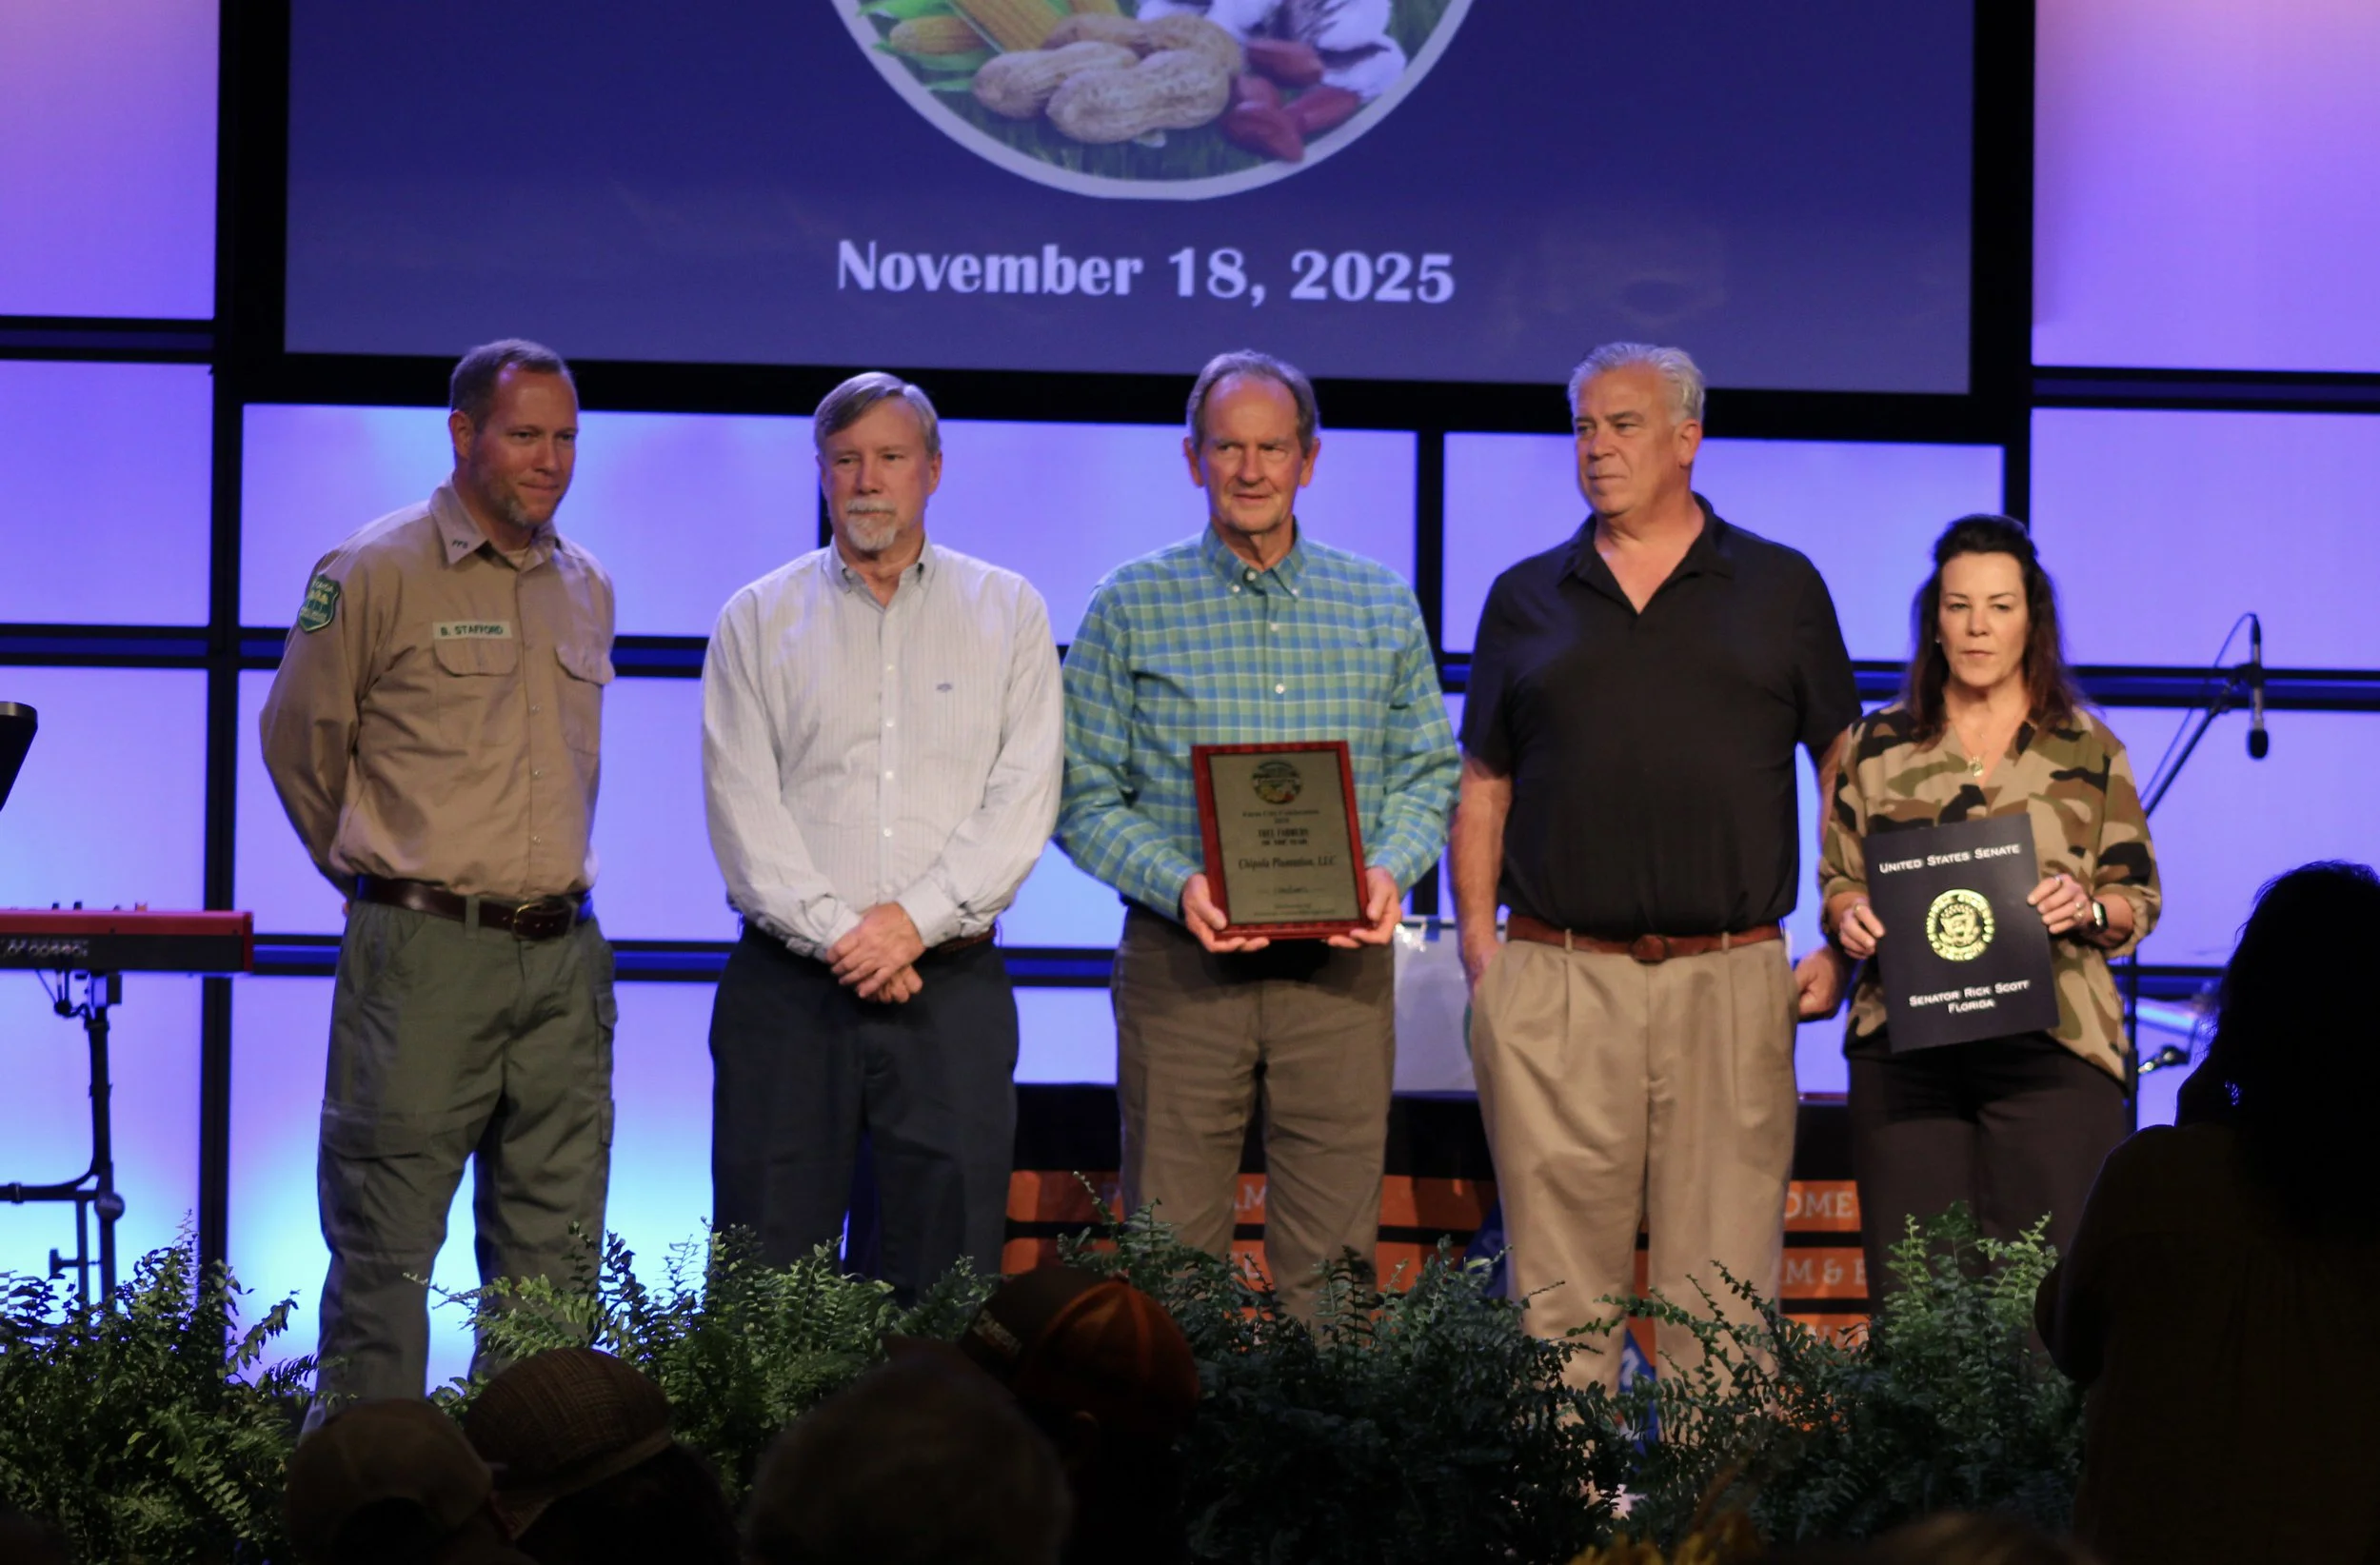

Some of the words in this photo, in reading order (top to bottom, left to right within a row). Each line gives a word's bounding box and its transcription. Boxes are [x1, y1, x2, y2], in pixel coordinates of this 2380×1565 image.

[838, 240, 1143, 295] November
[1168, 247, 1266, 307] 18,
[1290, 249, 1455, 304] 2025
[454, 624, 504, 636] STAFFORD
[1879, 859, 1924, 874] UNITED
[1927, 851, 1970, 866] STATES
[1973, 843, 2021, 860] SENATE
[1909, 990, 1961, 1007] SENATOR
[1964, 986, 1992, 999] RICK
[1994, 980, 2030, 994] SCOTT
[1948, 1000, 1995, 1014] FLORIDA
[1784, 1191, 1854, 1218] OME
